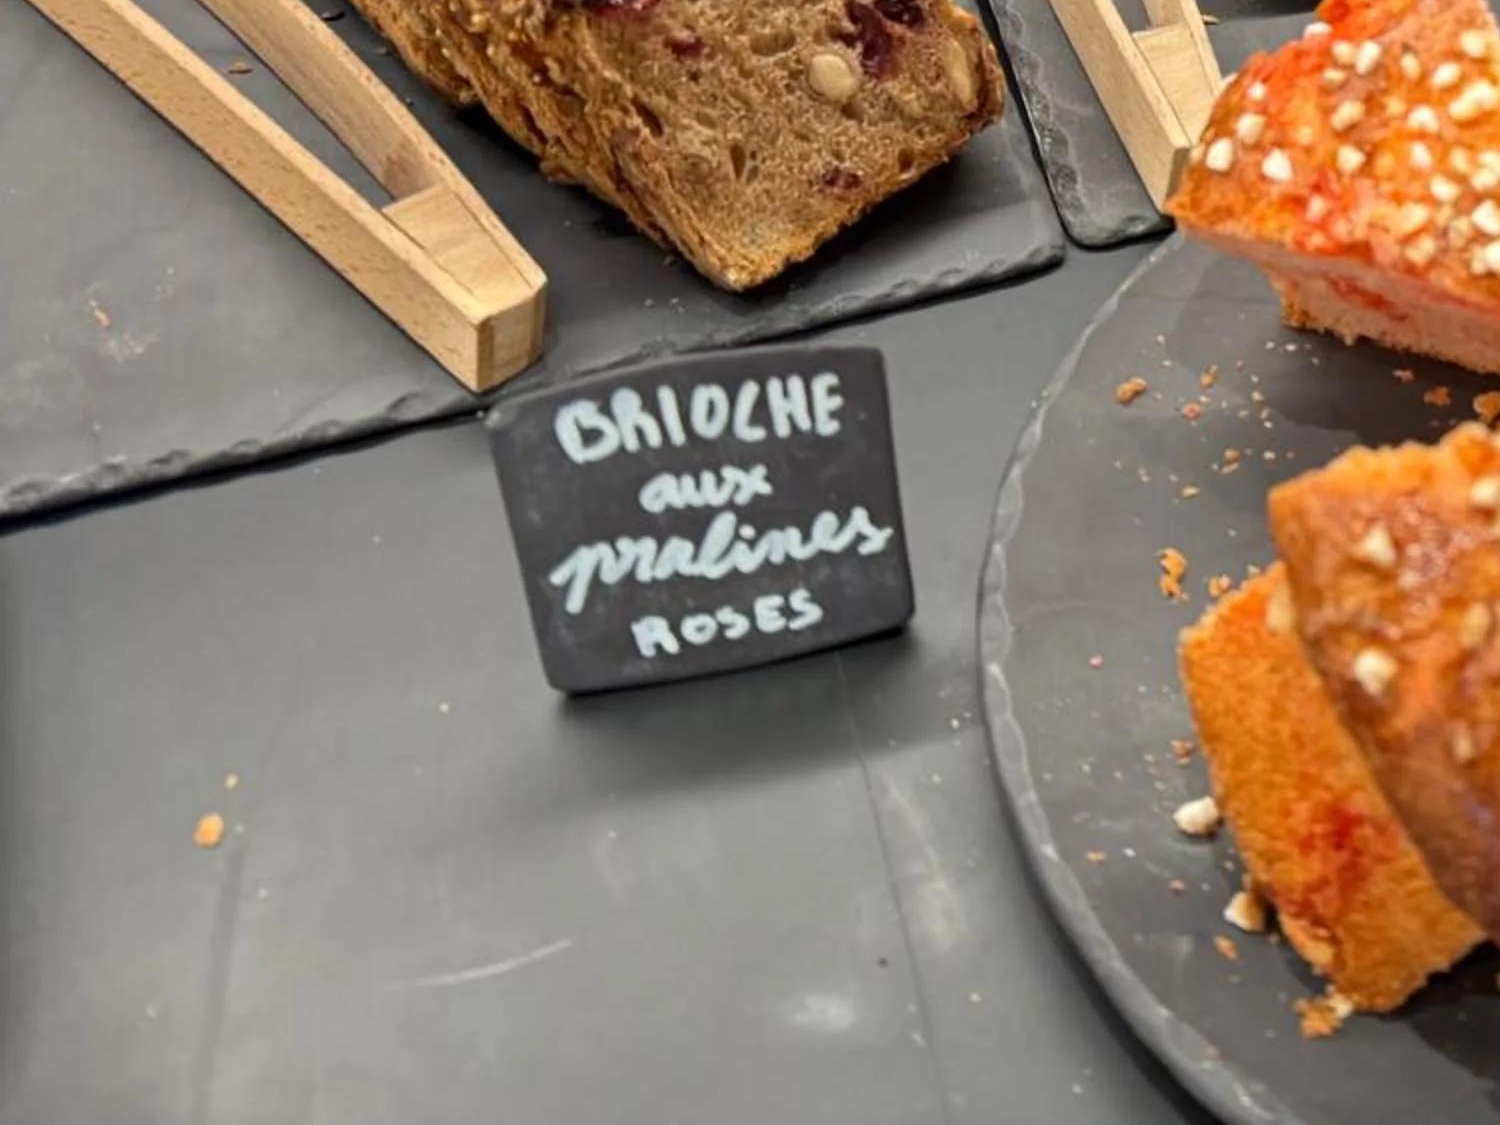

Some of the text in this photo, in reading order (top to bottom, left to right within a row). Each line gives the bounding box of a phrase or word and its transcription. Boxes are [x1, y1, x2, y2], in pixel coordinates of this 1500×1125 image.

[555, 372, 844, 465] BRIOCHE
[639, 465, 773, 513] aux
[549, 506, 893, 615] pralines
[631, 588, 824, 658] ROSES
